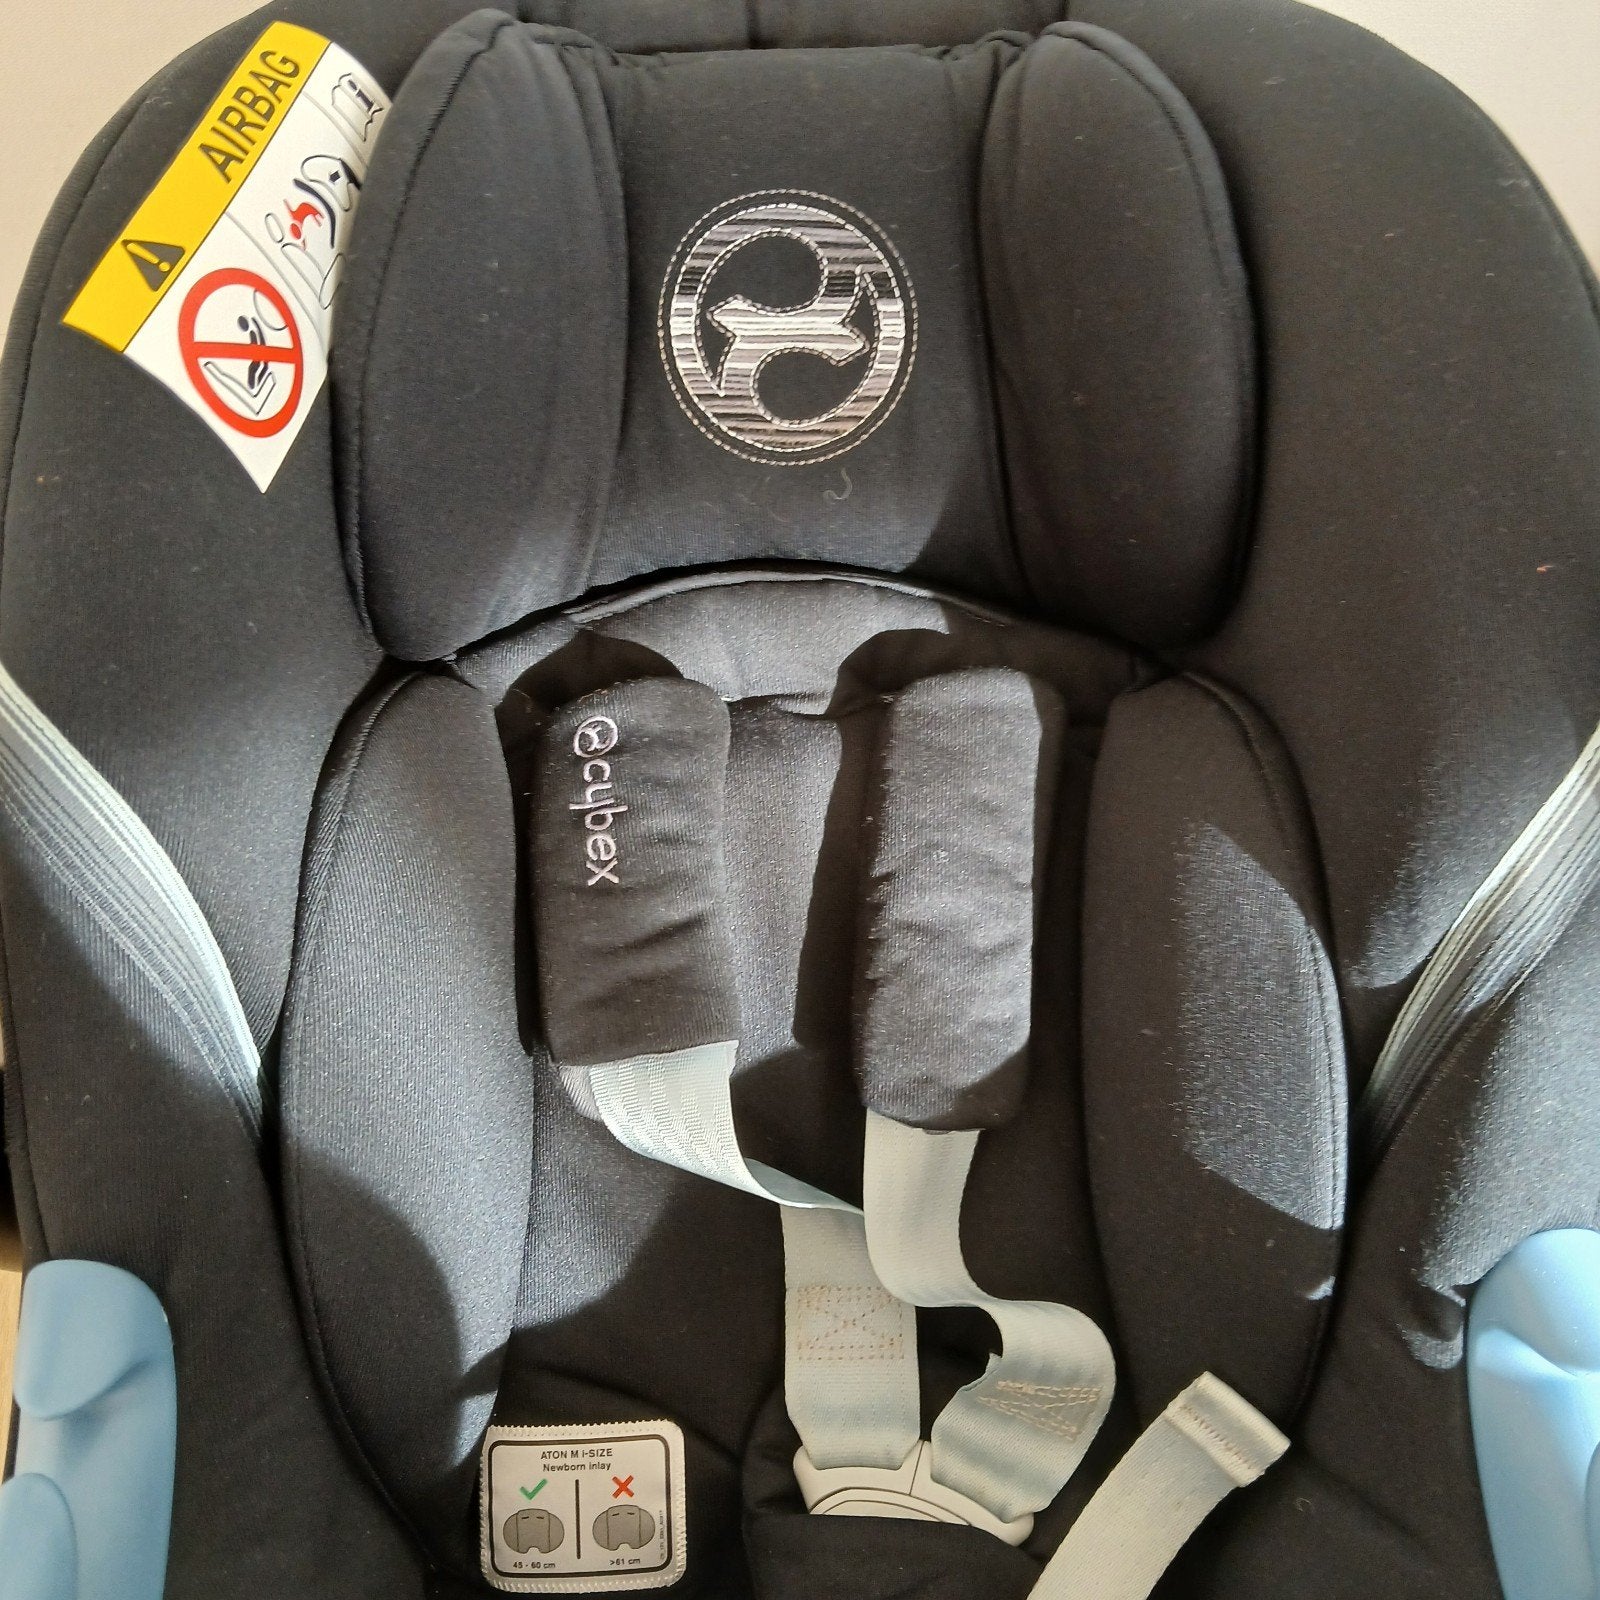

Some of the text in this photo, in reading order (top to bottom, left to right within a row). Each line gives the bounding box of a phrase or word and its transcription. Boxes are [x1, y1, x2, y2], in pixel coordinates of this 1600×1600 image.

[199, 49, 300, 184] AIRBAG
[569, 759, 629, 886] cybex
[540, 1448, 613, 1460] ATON M i-SIZE
[542, 1461, 612, 1472] Newborn inlay
[513, 1561, 523, 1569] 45
[531, 1561, 541, 1569] 60
